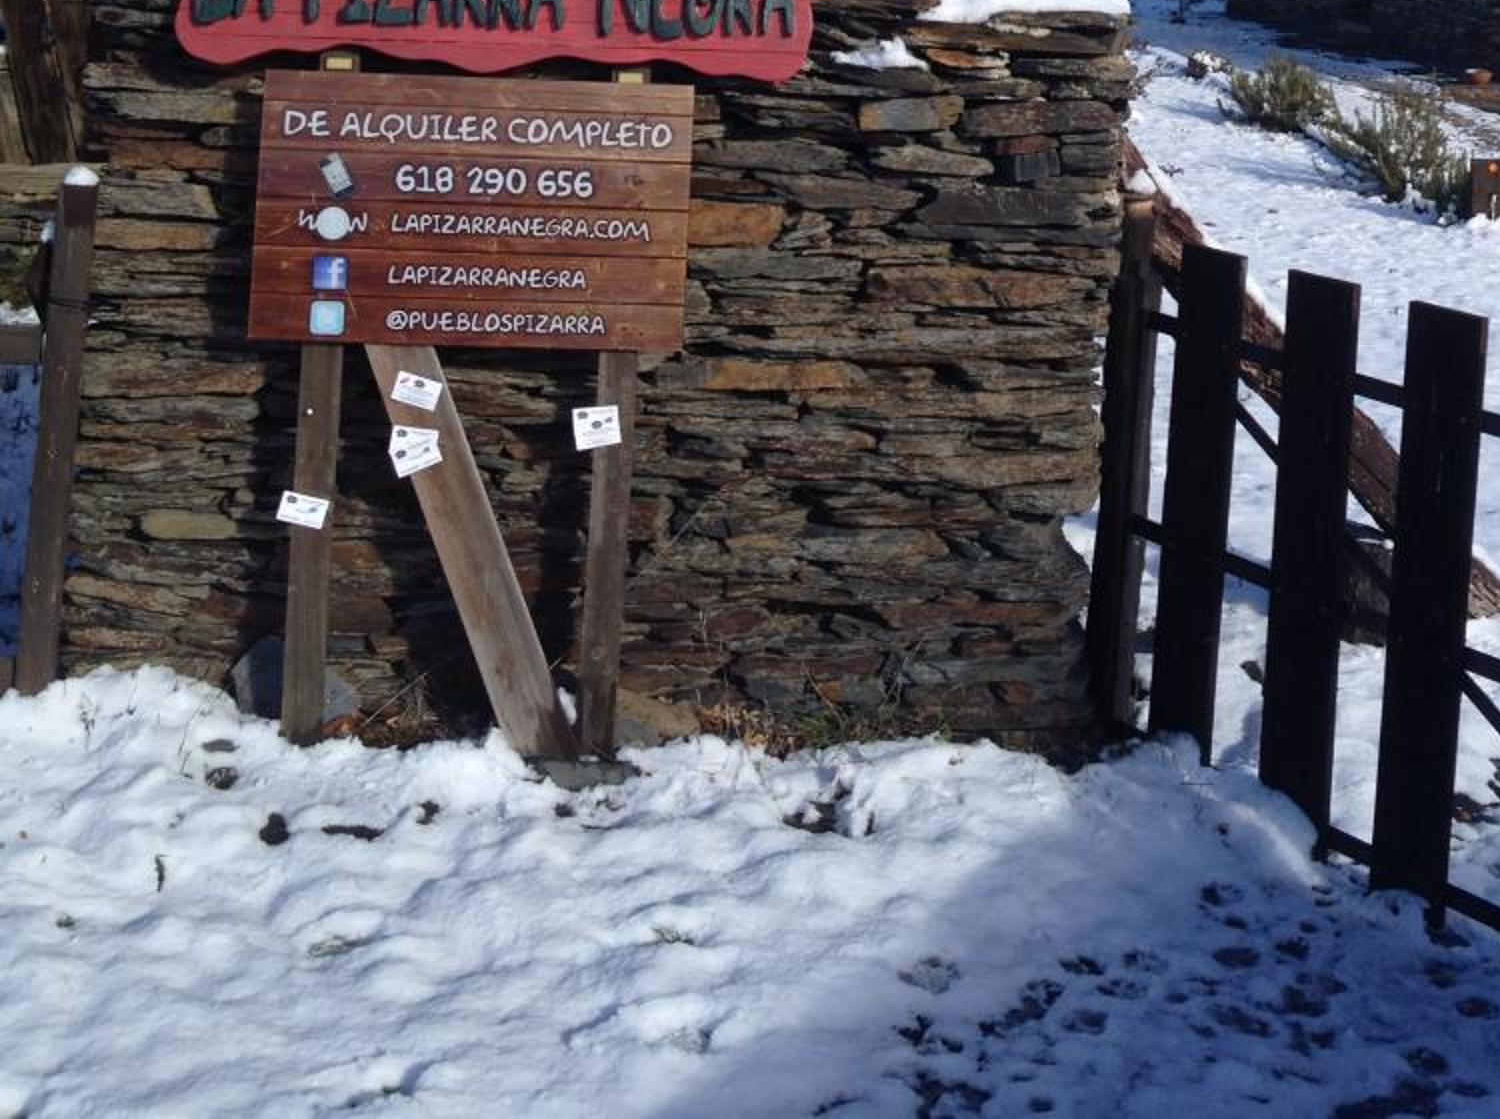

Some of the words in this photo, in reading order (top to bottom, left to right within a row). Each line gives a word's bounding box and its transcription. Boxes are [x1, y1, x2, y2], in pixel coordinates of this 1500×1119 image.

[283, 109, 331, 137] DE
[339, 112, 498, 144] ALQUILER
[507, 117, 674, 150] COMPLETO
[395, 164, 454, 193] 618
[465, 167, 527, 196] 290
[537, 169, 594, 199] 656
[390, 213, 651, 242] LAPIZARRANEGRA.COM
[386, 263, 587, 289] LAPIZARRANEGRA
[386, 309, 606, 336] @PUEBLOSPIZARRA
